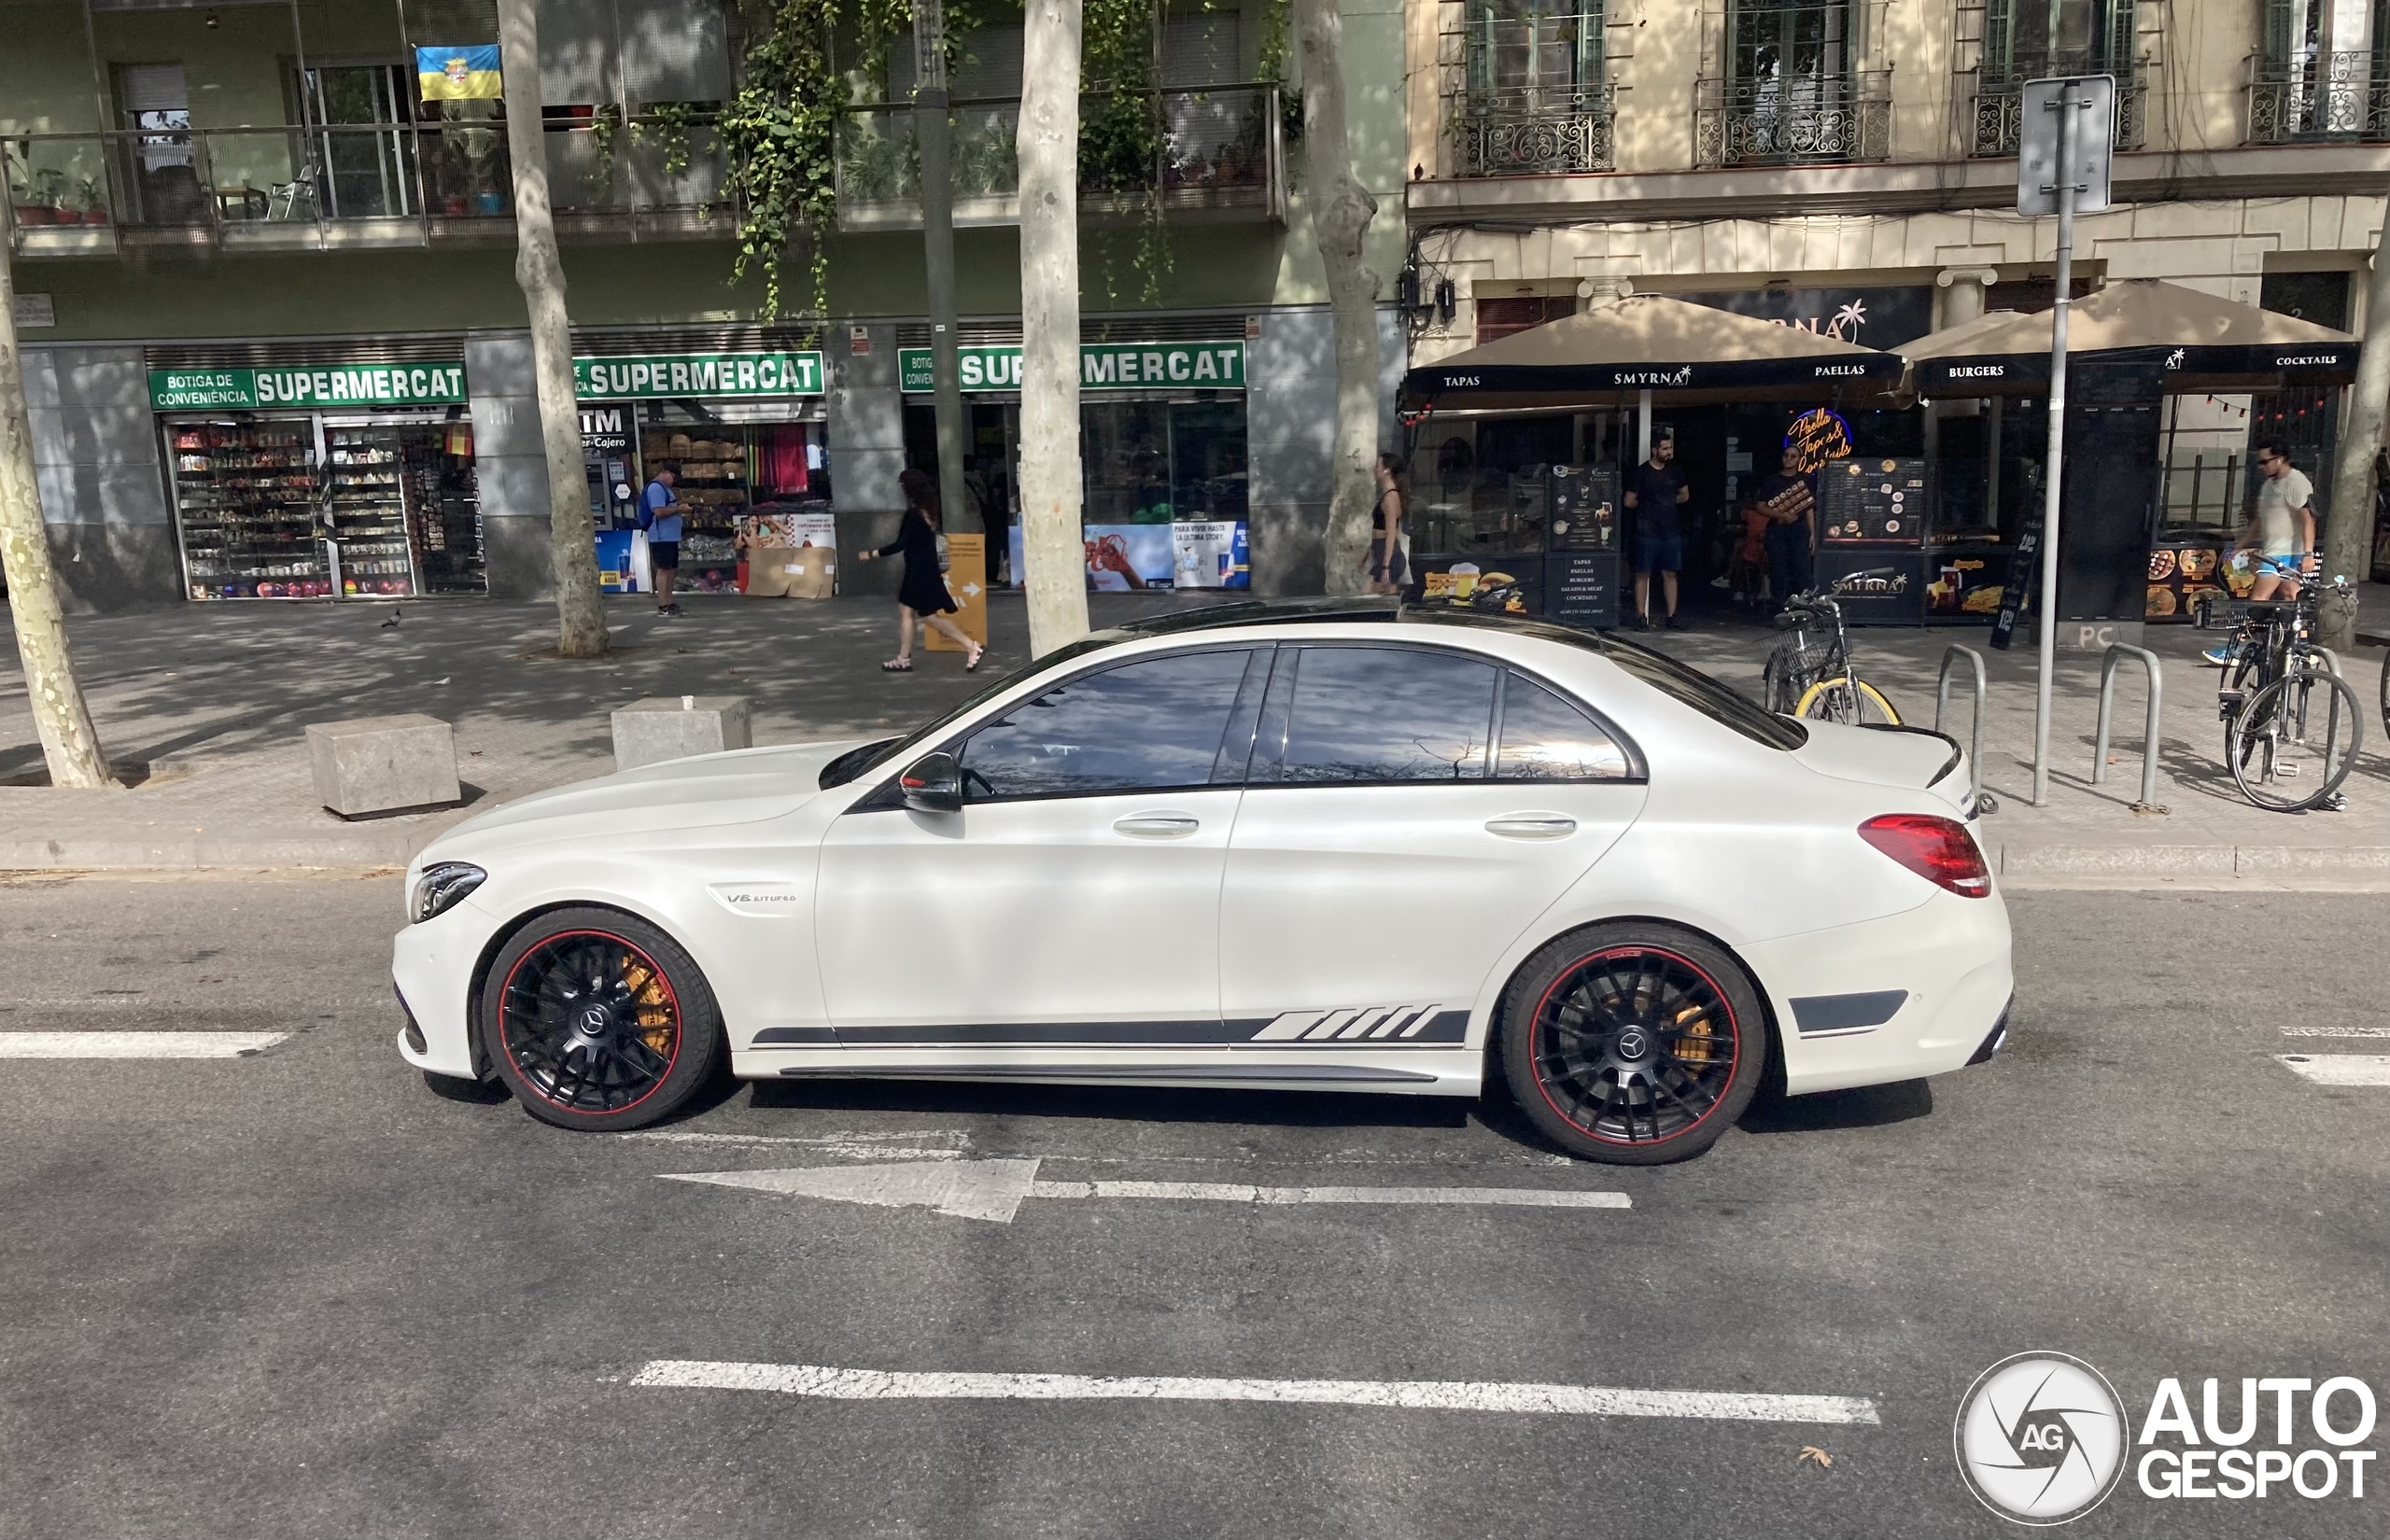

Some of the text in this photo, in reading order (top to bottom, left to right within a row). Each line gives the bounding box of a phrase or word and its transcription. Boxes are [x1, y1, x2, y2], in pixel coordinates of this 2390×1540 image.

[961, 349, 1238, 385] SUPMERCAT
[2276, 356, 2337, 366] COCKTAILS
[590, 358, 815, 393] SUPERMERCAT
[1613, 372, 1683, 385] SMYRNA
[1815, 365, 1865, 376] PAELLAS
[1948, 366, 2004, 378] BURGERS
[167, 374, 234, 389] BOTIGA DE
[257, 369, 461, 402] SUPERMERCAT
[1443, 376, 1481, 386] TAPAS
[157, 389, 249, 406] CONVENIÈNCIA
[577, 409, 623, 433] TM
[1787, 407, 1832, 439] Paella
[1831, 579, 1898, 592] SMYRNA
[2080, 626, 2114, 649] PC
